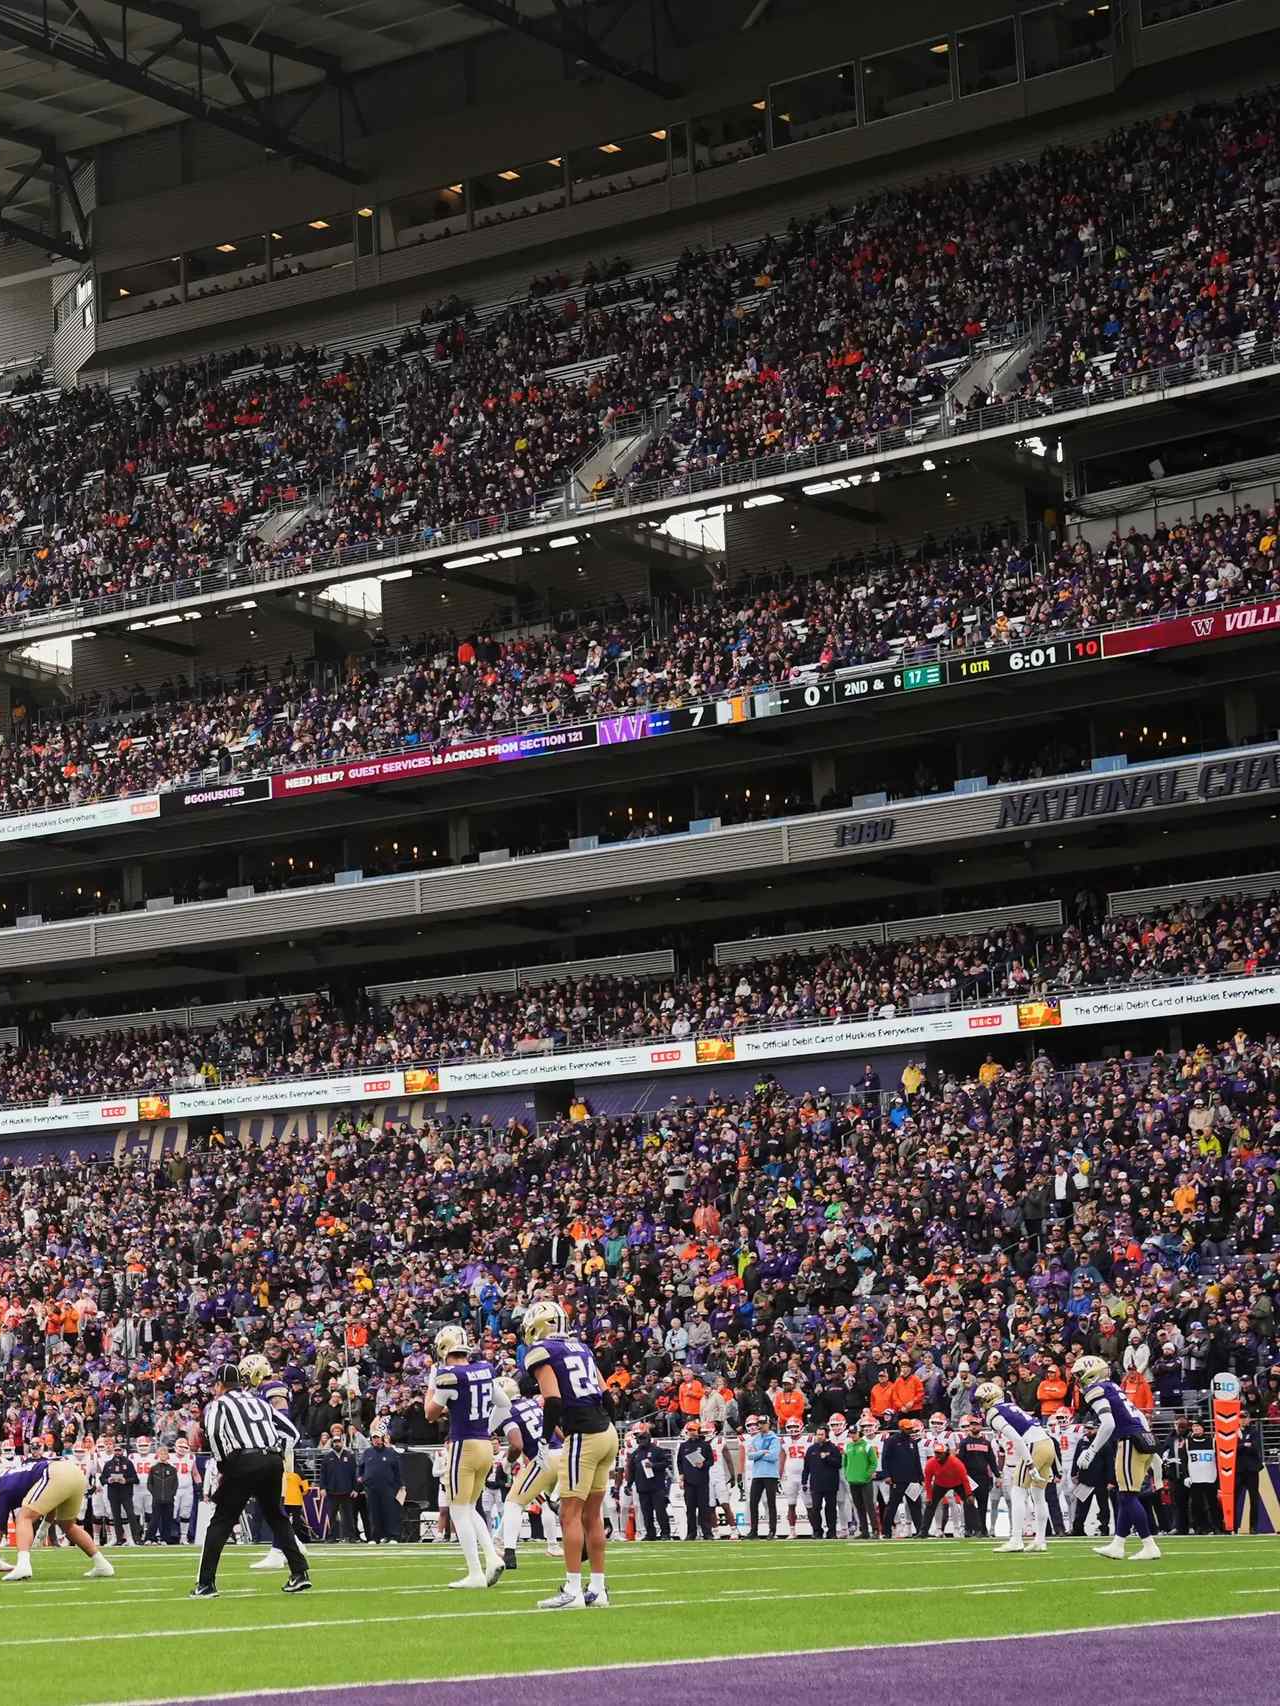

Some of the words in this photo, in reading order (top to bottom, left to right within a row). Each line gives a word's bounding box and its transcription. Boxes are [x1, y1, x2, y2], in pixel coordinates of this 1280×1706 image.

[1075, 640, 1098, 656] 10
[970, 659, 990, 675] QTR
[1009, 646, 1057, 671] 6:01
[844, 680, 868, 696] 2ND
[873, 678, 884, 690] &
[893, 675, 901, 688] 6
[908, 672, 921, 684] 17
[804, 686, 820, 706] 0
[688, 707, 704, 727] 7
[285, 775, 313, 789] NEED
[314, 771, 345, 785] HELP?
[348, 763, 381, 779] GUEST
[382, 756, 431, 773] SERVICES
[444, 748, 487, 764] ACROSS
[487, 741, 518, 756] FROM
[519, 733, 566, 750] SECTION
[568, 731, 583, 743] 121
[184, 786, 245, 805] #GOHUSKIES
[995, 768, 1188, 830] NATIONAL
[57, 812, 96, 826] Everywhere
[1074, 1006, 1088, 1016] The
[1092, 1002, 1123, 1014] Official
[1125, 999, 1149, 1010] Debit
[1151, 997, 1171, 1007] Card
[1174, 996, 1183, 1005] of
[1186, 992, 1220, 1003] Huskies
[1222, 986, 1275, 999] Everywhere
[970, 1016, 1001, 1027] BECU
[746, 1042, 759, 1051] The
[762, 1039, 789, 1049] Official
[791, 1036, 813, 1046] Debit
[815, 1034, 833, 1044] Card
[834, 1033, 843, 1042] of
[845, 1030, 876, 1040] Huskies
[878, 1025, 924, 1037] Everywhere
[652, 1052, 680, 1062] BECU
[449, 1073, 461, 1083] The
[464, 1070, 489, 1081] Official
[511, 1067, 528, 1076] Card
[568, 1059, 610, 1071] Everywhere
[563, 1356, 601, 1399] 24
[469, 1382, 494, 1421] 12
